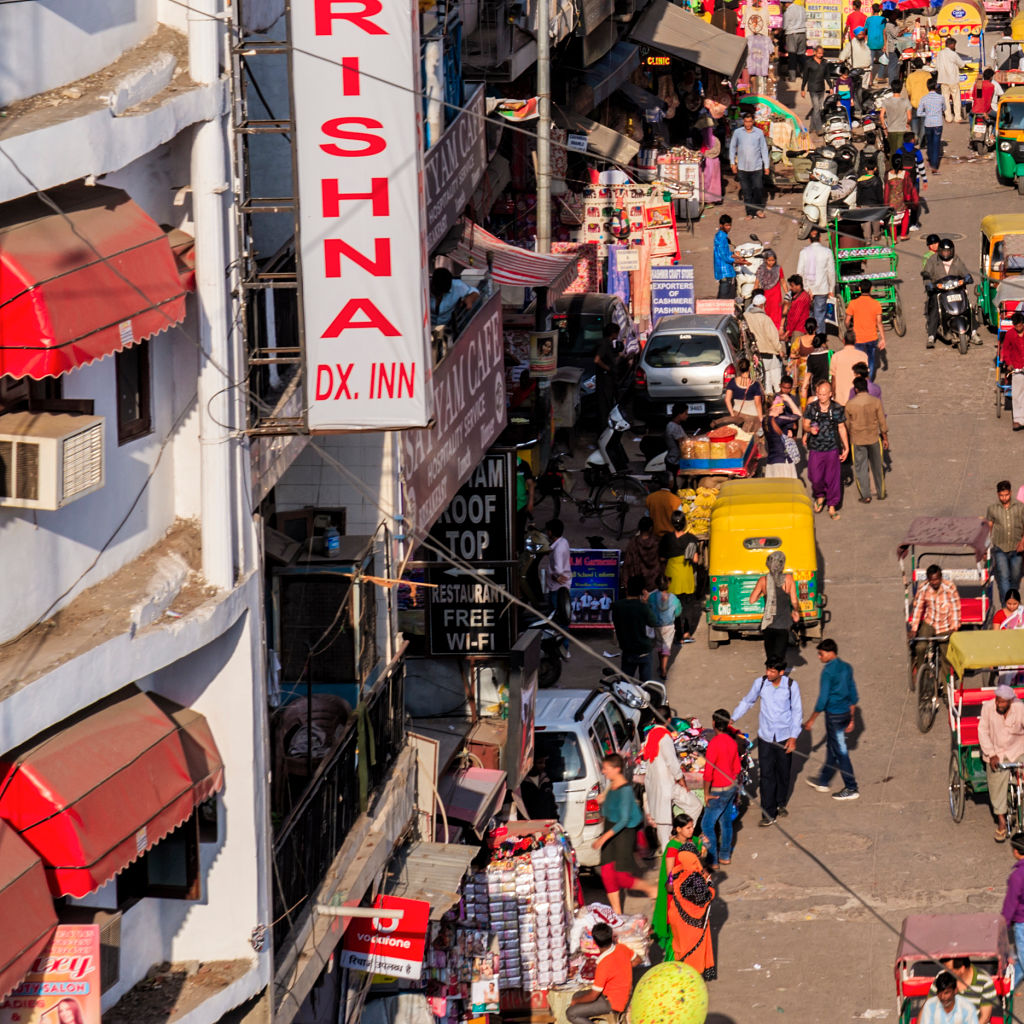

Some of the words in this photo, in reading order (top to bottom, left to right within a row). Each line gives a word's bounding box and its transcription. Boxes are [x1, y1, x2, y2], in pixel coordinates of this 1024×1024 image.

[647, 56, 670, 66] CLINIC
[652, 282, 694, 290] EXPORTERS
[653, 297, 693, 305] CASHMERE
[467, 310, 502, 397] CAFE
[315, 363, 360, 401] DX.
[369, 362, 416, 399] INN
[427, 414, 464, 488] HOSPITALITY
[463, 391, 486, 439] SERVICE
[445, 530, 490, 560] TOP
[431, 583, 506, 604] RESTAURANT
[444, 608, 496, 627] FREE
[446, 632, 495, 651] WI-FI
[356, 932, 411, 949] vodafone
[42, 983, 86, 993] SALON
